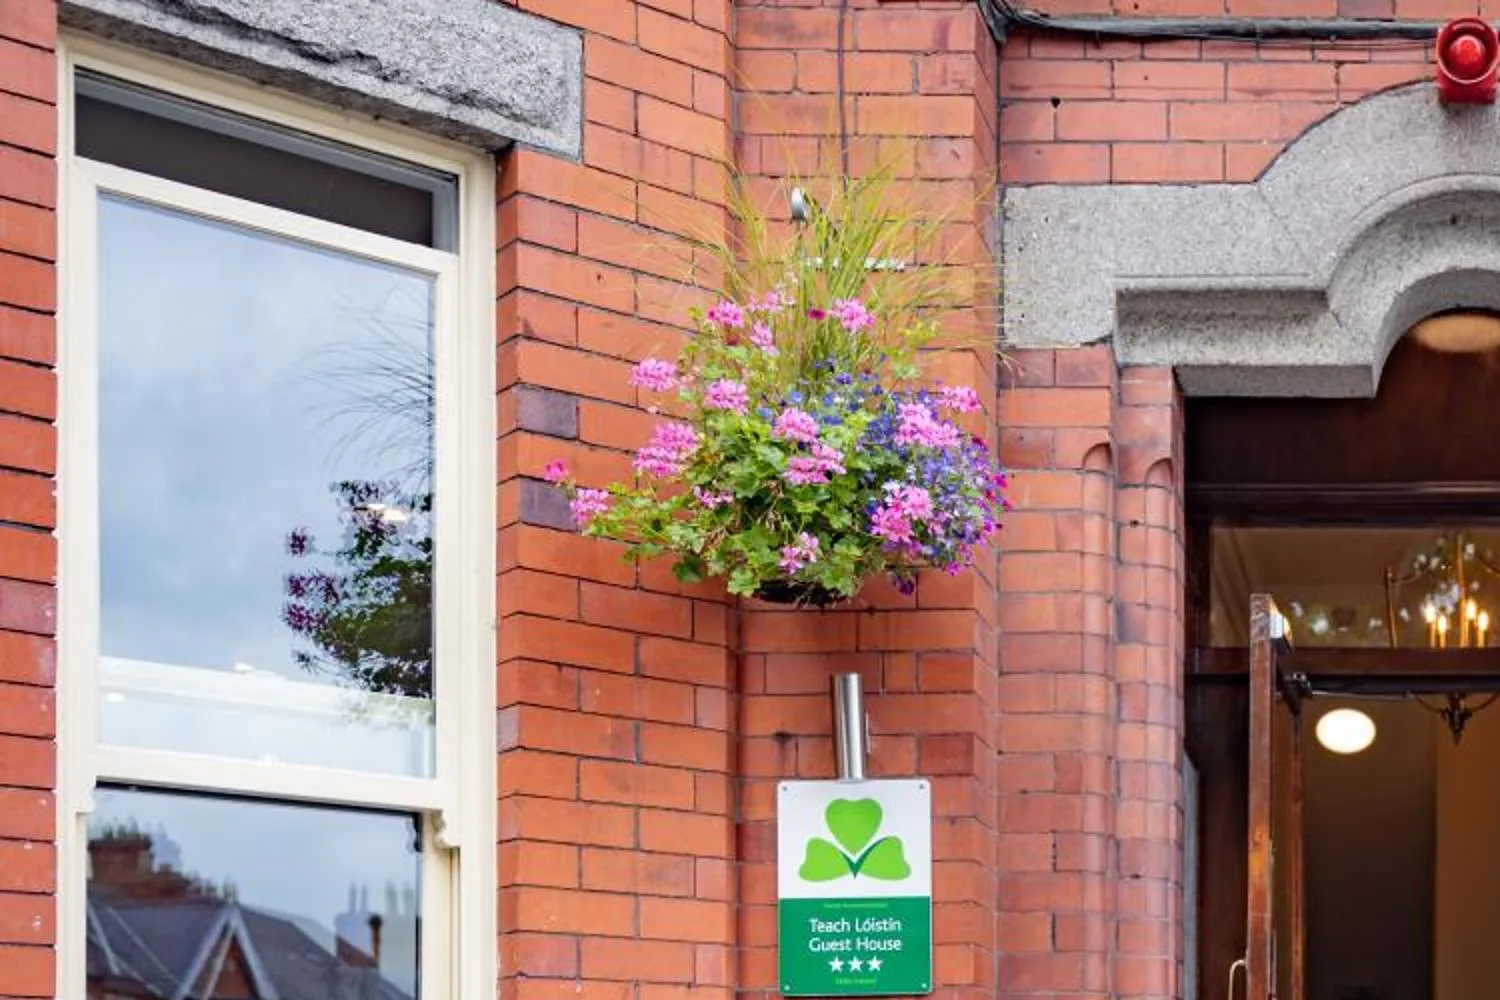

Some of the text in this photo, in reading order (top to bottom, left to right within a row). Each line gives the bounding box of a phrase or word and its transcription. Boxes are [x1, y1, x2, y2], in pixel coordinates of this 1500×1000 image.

[808, 917, 850, 933] Teach
[808, 937, 903, 952] Guest House
